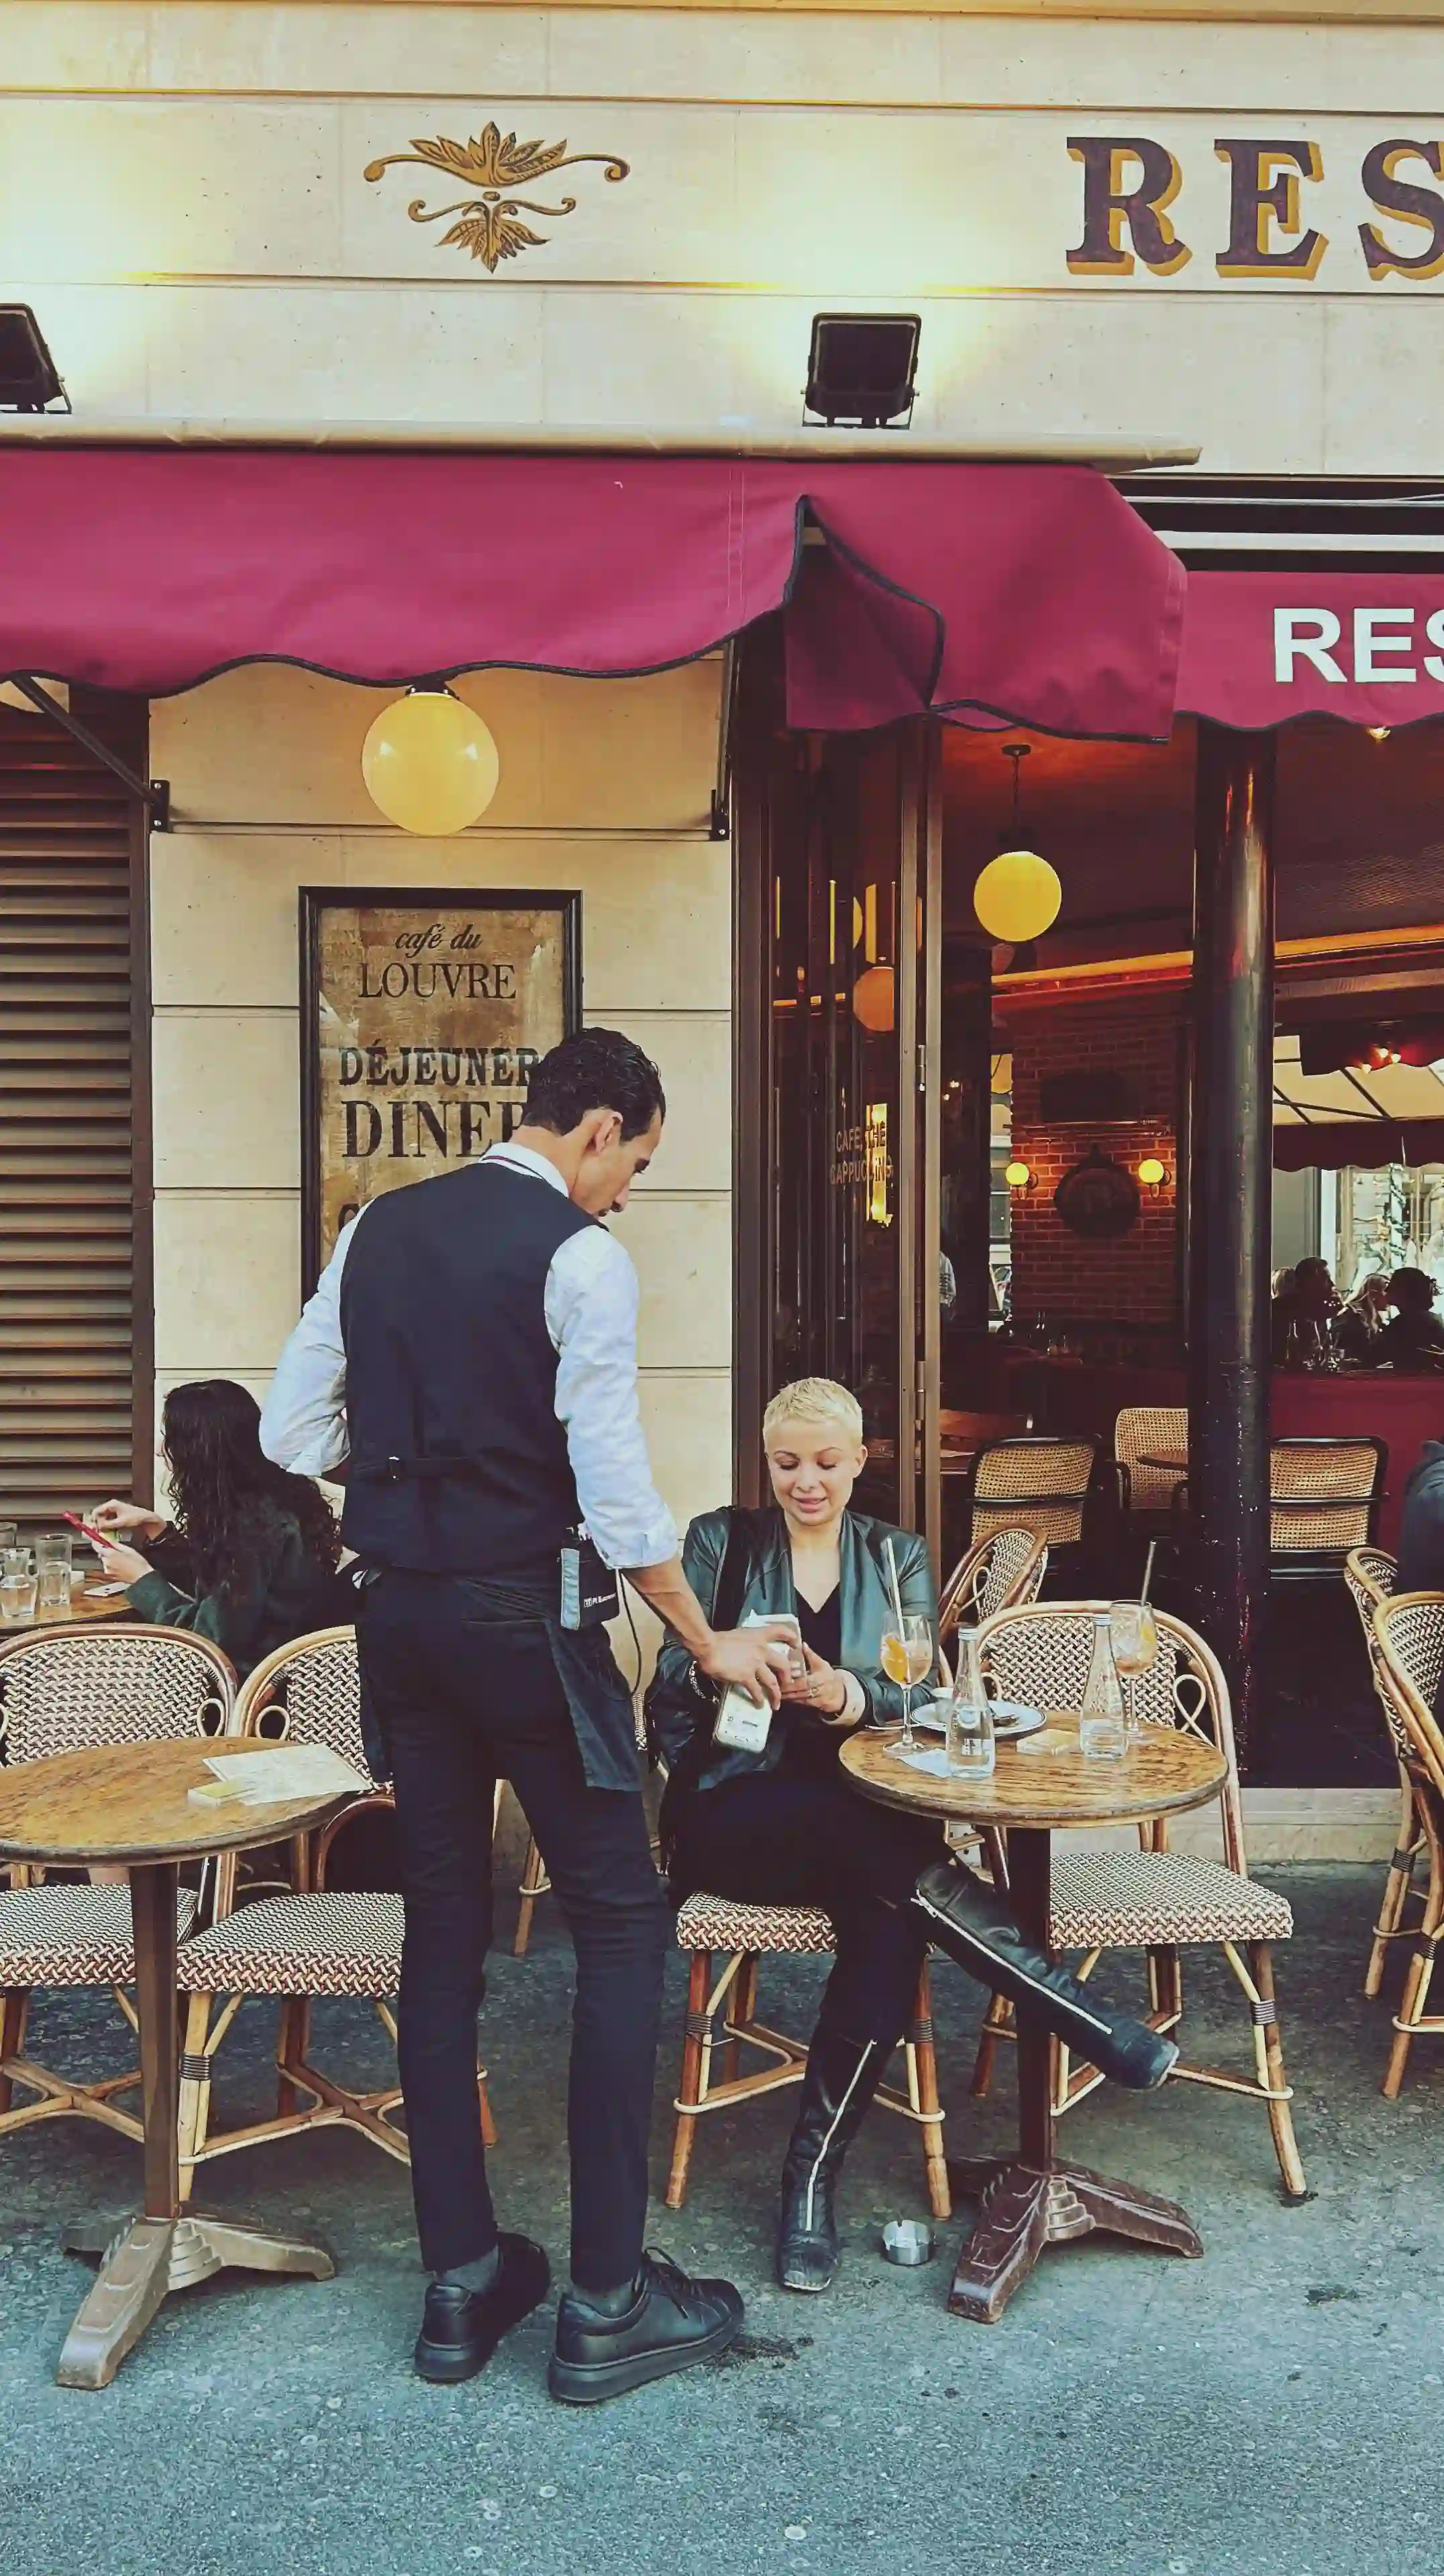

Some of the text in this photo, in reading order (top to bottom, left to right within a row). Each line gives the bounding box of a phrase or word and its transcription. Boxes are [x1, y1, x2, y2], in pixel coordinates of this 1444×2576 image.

[1066, 136, 1444, 280] RES
[395, 923, 482, 959] café du
[358, 962, 517, 999] LOUVRE
[338, 1038, 539, 1087] DÉJEUNER
